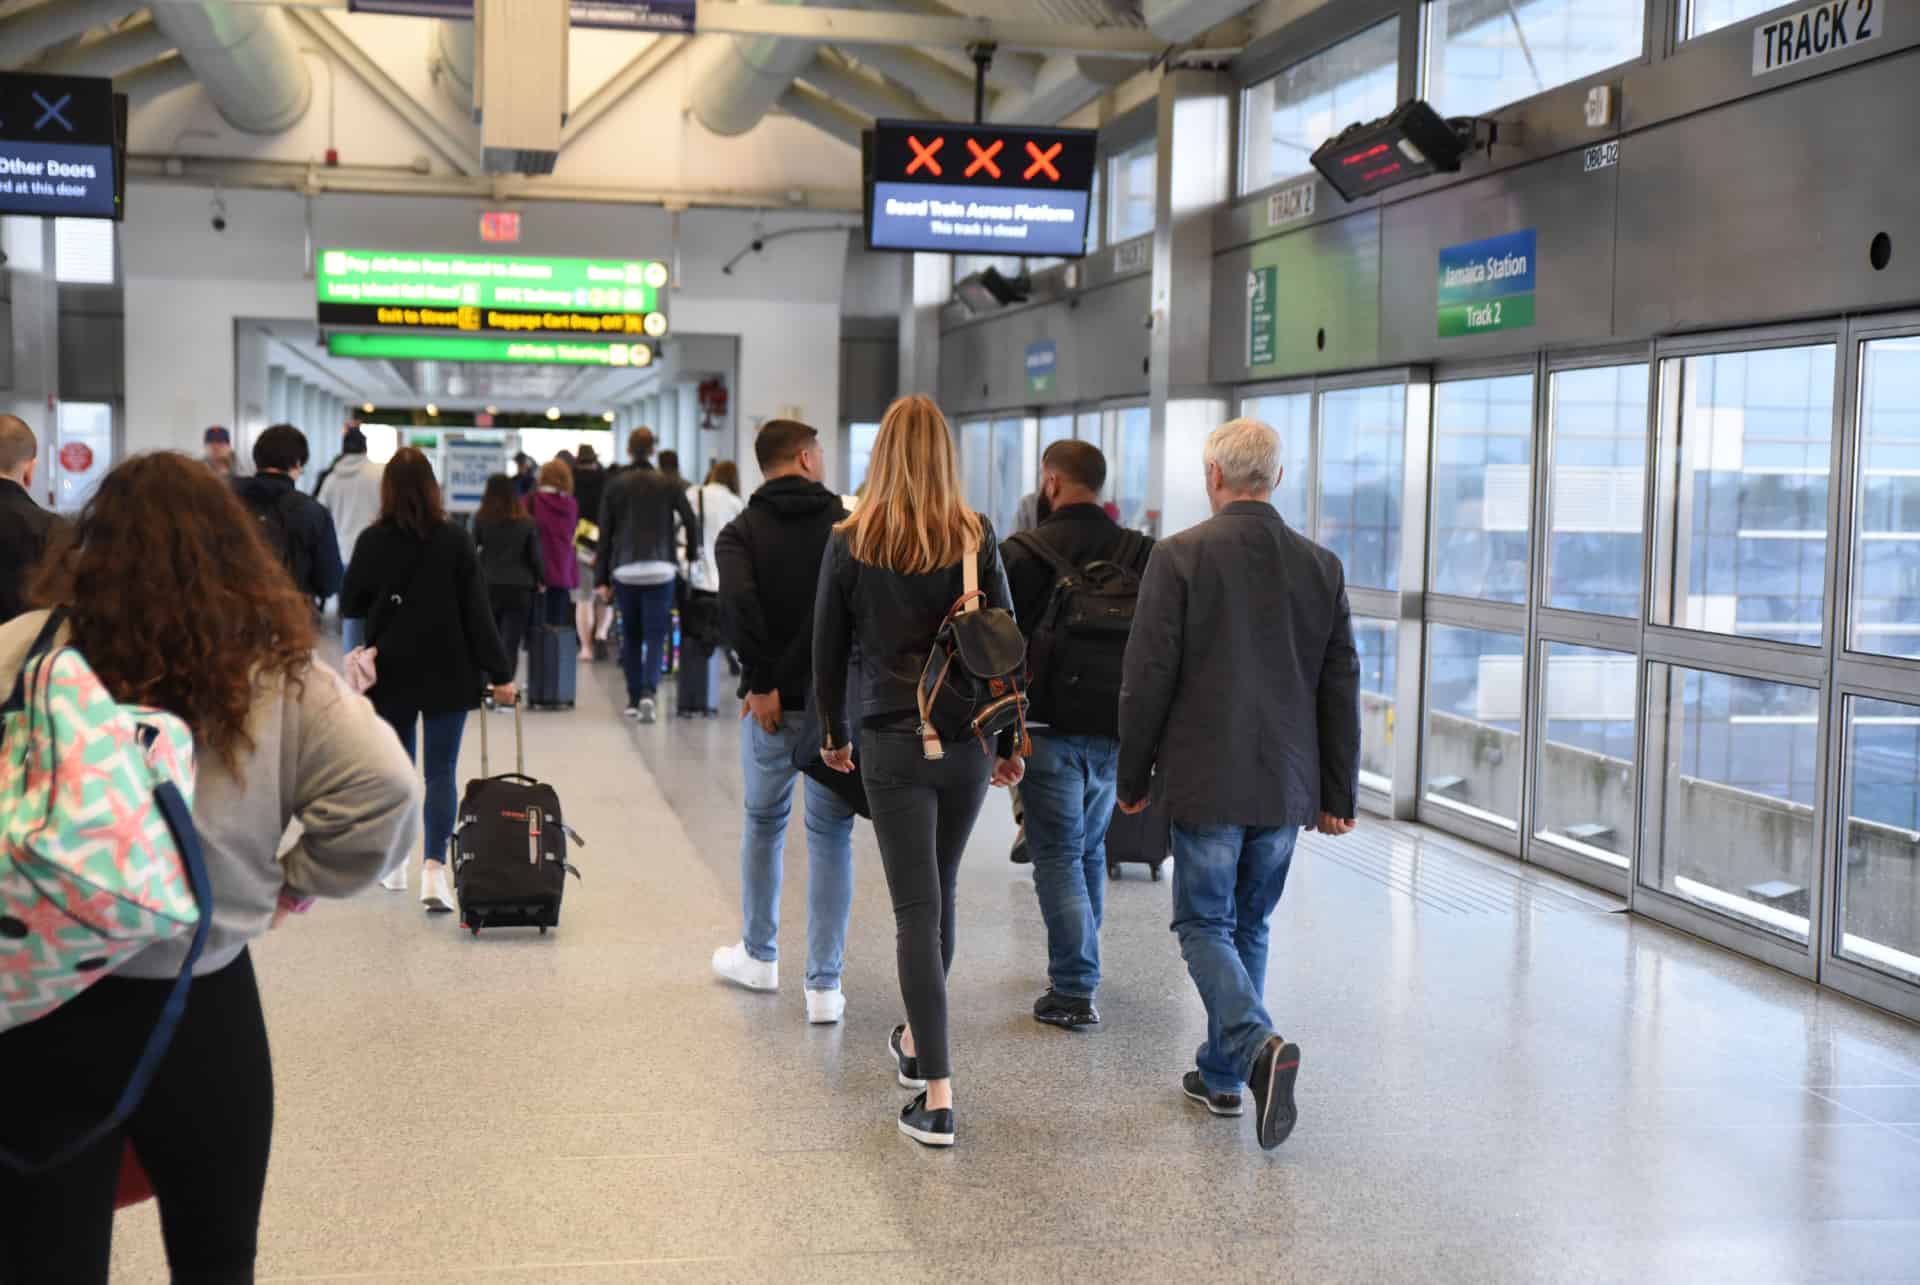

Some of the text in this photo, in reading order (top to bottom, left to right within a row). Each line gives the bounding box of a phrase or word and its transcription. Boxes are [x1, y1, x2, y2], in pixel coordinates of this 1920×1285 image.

[1763, 0, 1872, 68] TRACK 2
[0, 157, 96, 179] Other Doors
[31, 180, 54, 195] this
[56, 182, 86, 197] door
[930, 200, 965, 218] Train
[1444, 252, 1527, 289] Jamaica Station
[1466, 301, 1502, 328] Track 2
